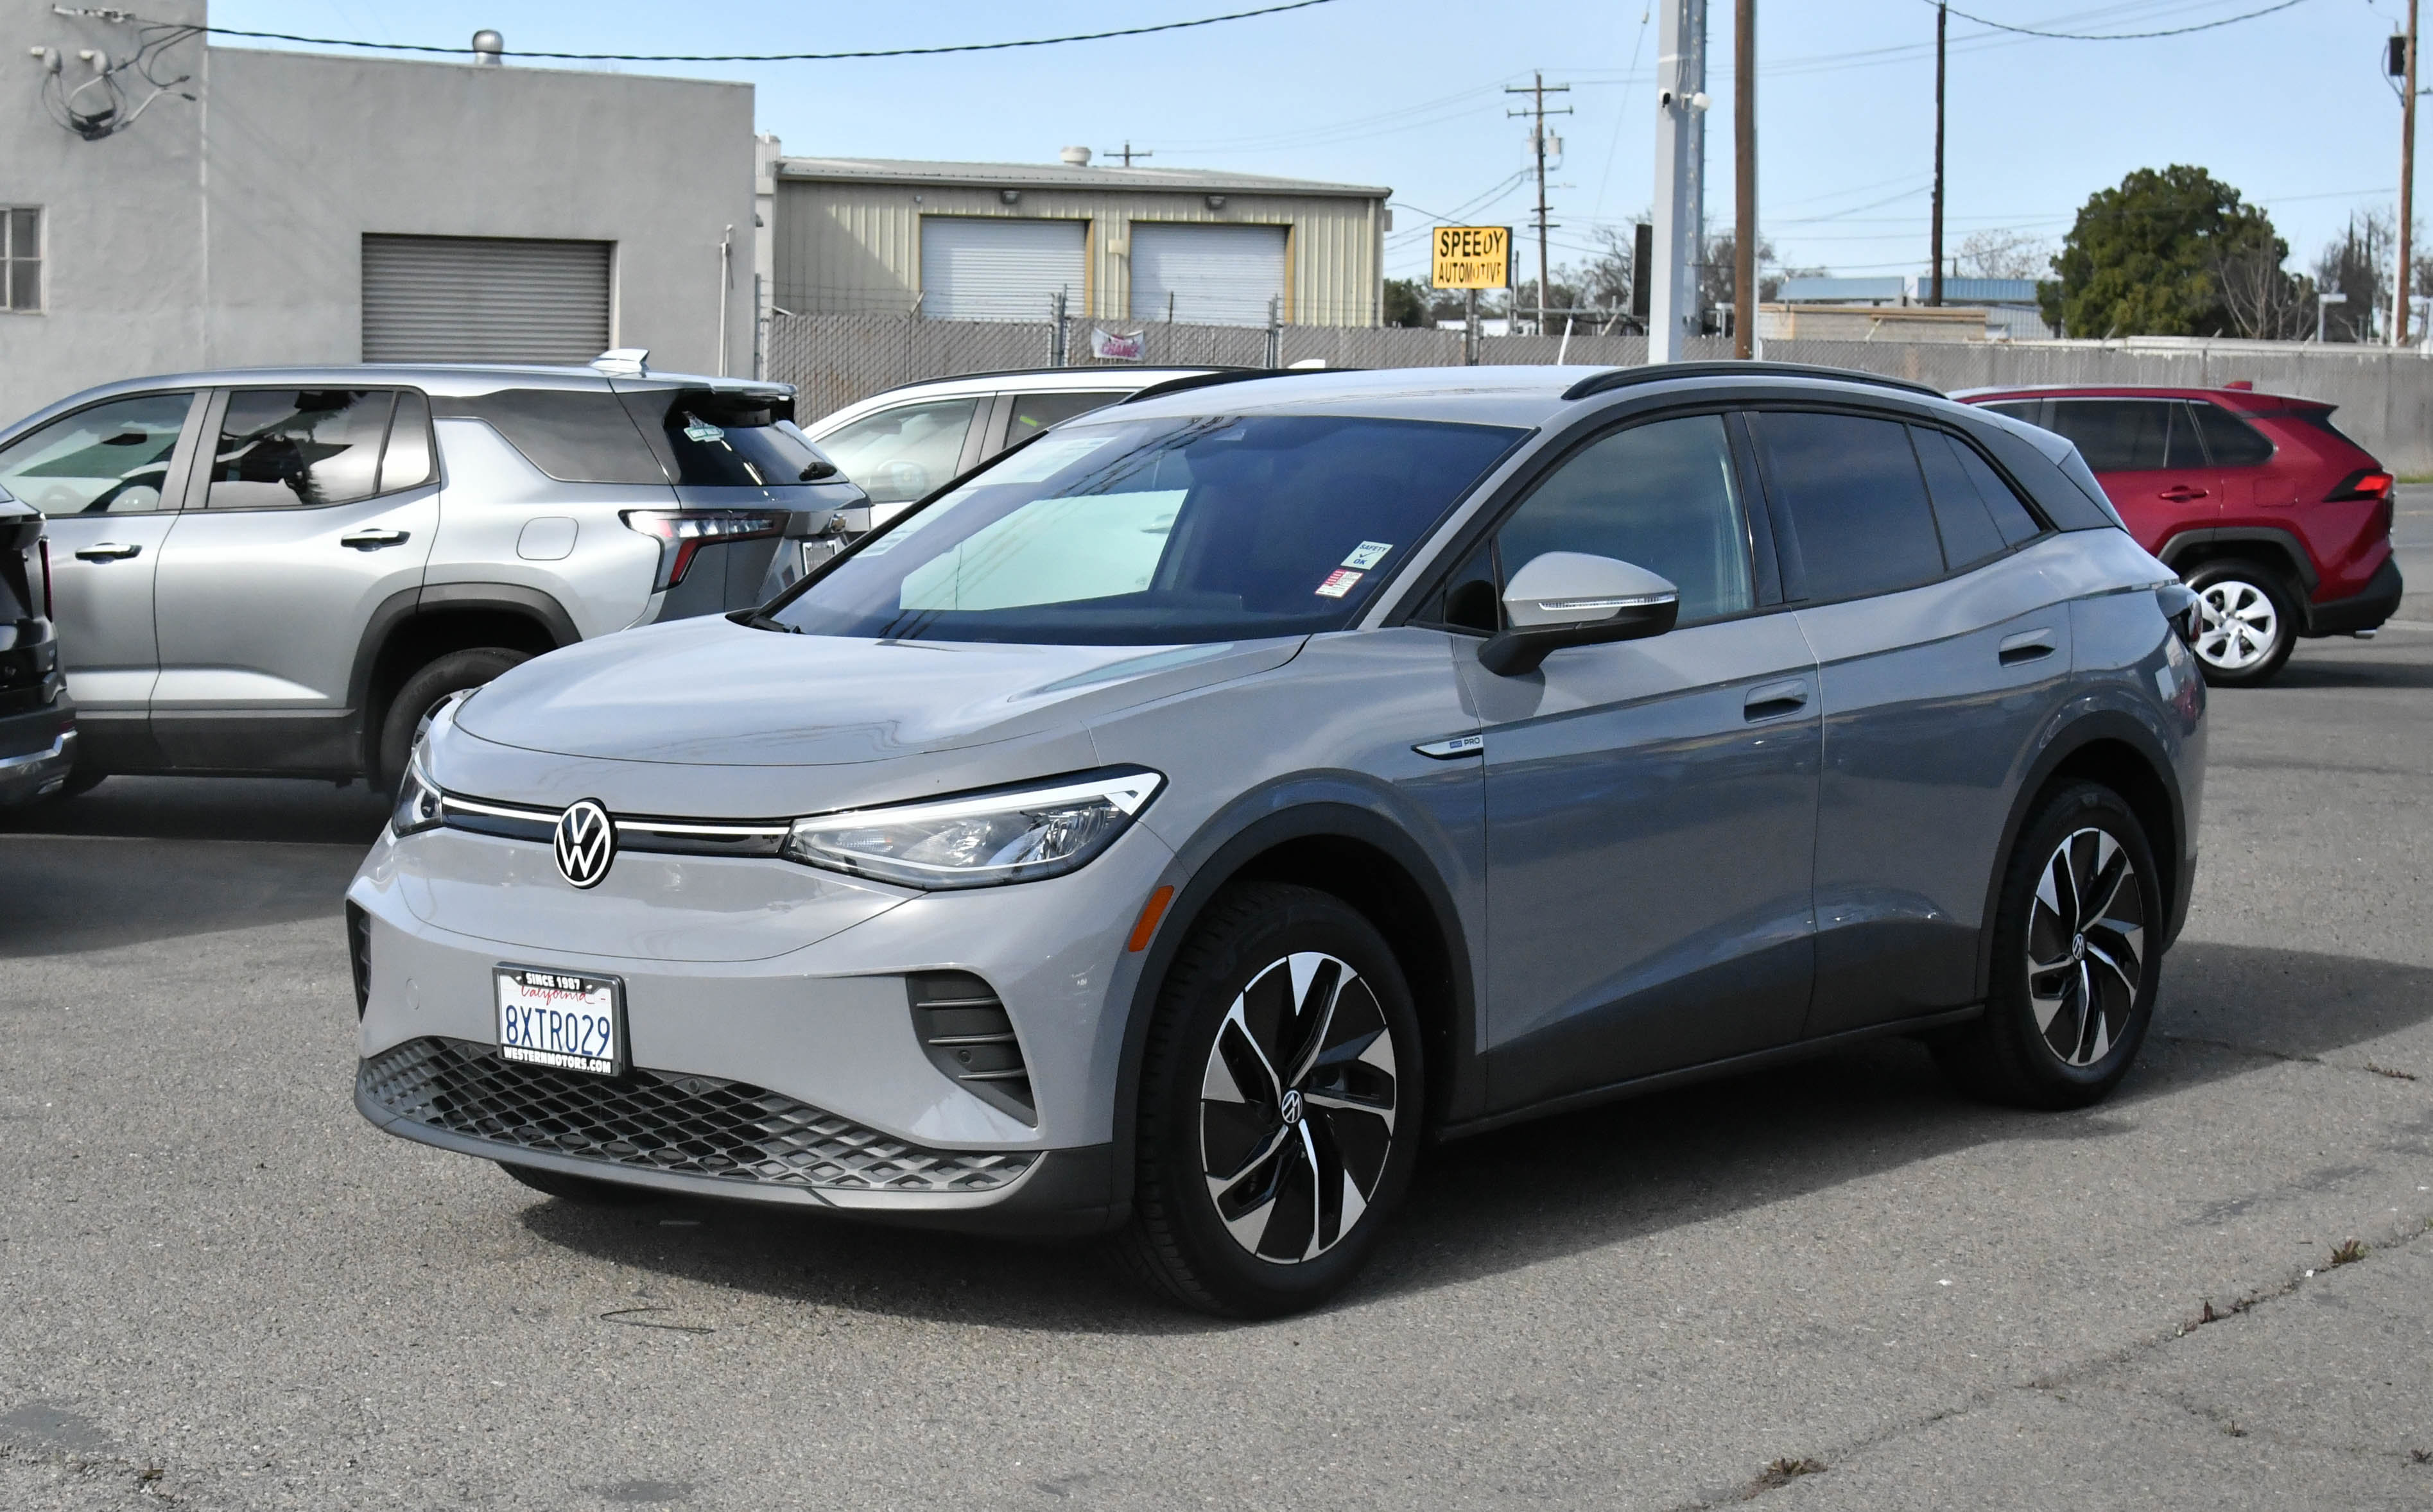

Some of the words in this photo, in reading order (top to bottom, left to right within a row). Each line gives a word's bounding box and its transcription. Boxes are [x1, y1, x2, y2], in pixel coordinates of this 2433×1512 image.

[1440, 230, 1504, 257] SPEEDY
[1359, 544, 1388, 552] SAFETY
[1464, 737, 1480, 746] PRO
[555, 803, 610, 884] VW
[525, 972, 555, 987] SINCE
[556, 977, 580, 990] 1987
[505, 1004, 610, 1057] 8XTR029
[503, 1046, 612, 1074] WESTERNMOTORS.COM
